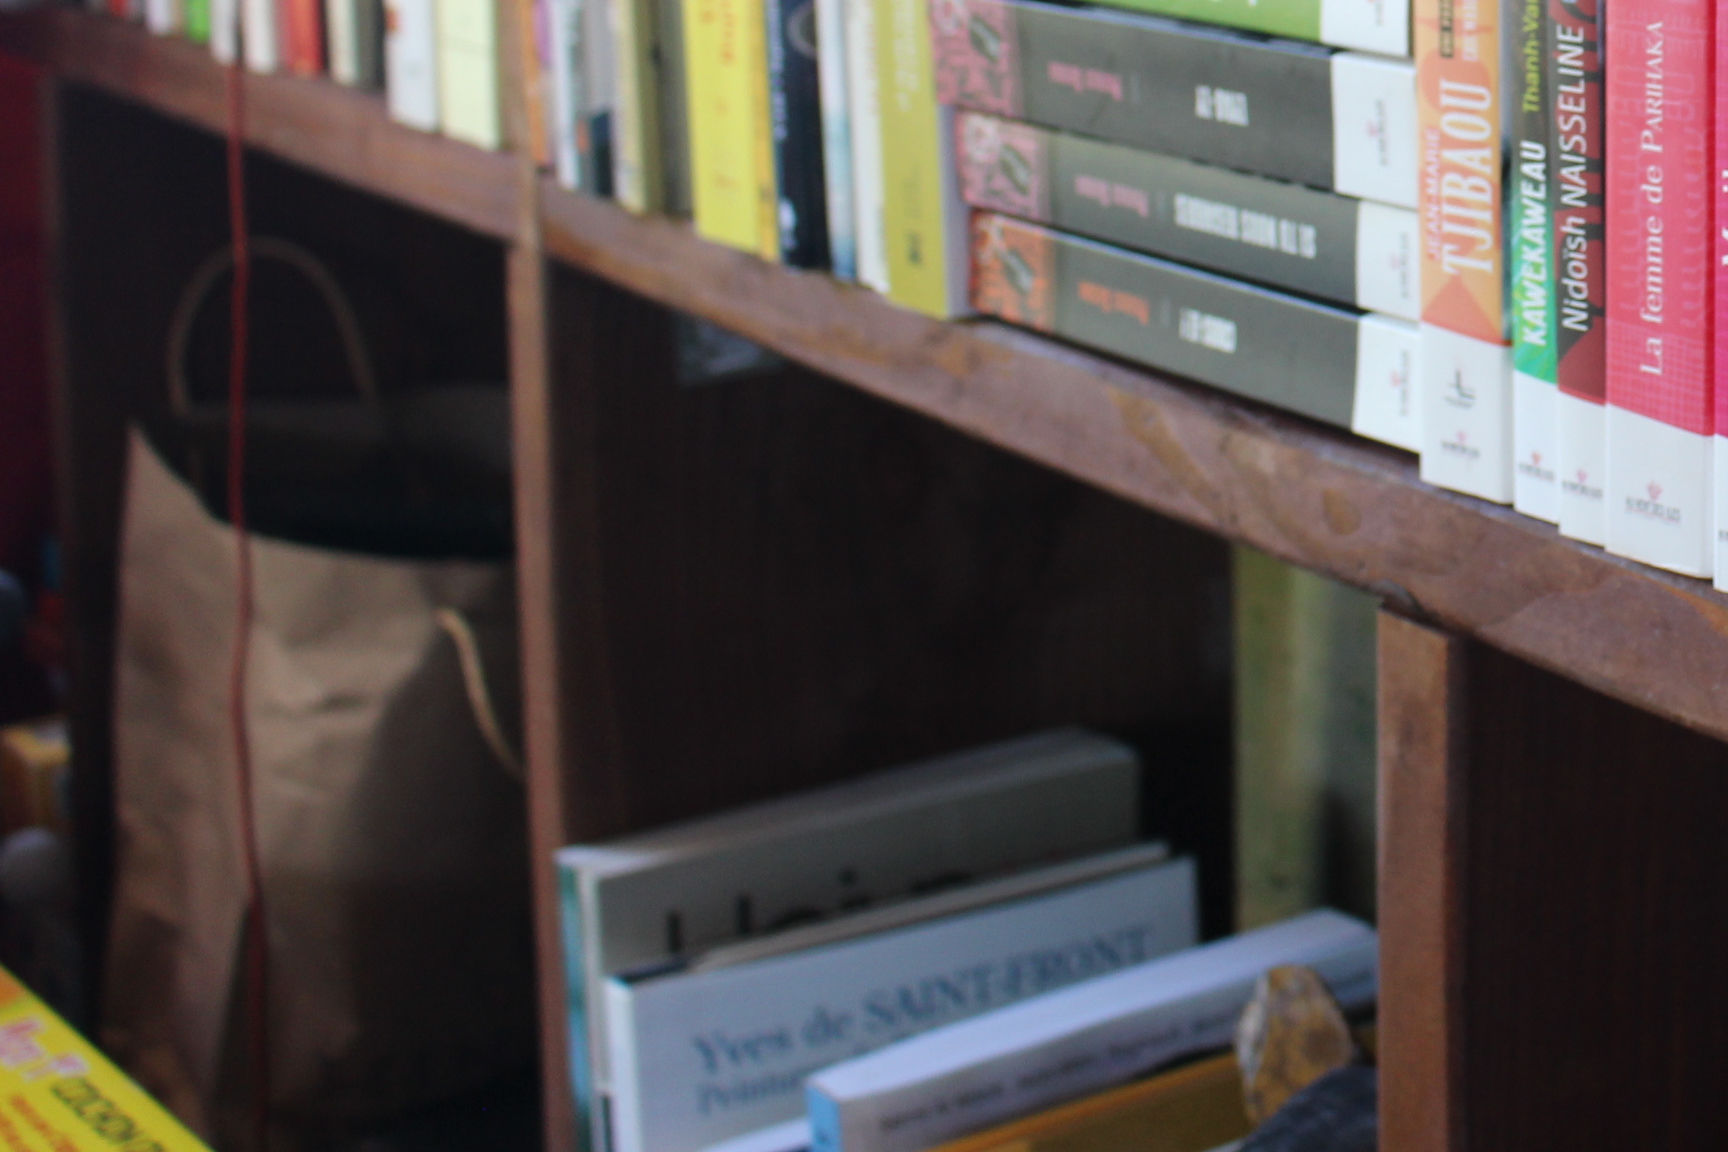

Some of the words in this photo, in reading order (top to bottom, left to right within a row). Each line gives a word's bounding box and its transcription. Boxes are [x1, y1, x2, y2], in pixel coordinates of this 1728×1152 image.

[1556, 24, 1587, 209] NAISSELINE
[1440, 78, 1494, 276] TJIBAOU
[1640, 164, 1664, 204] de
[1518, 140, 1547, 347] KAWEKAWEAU
[1561, 214, 1588, 332] Nidoïsh
[1640, 215, 1664, 324] femme
[1639, 336, 1663, 376] La
[800, 1005, 855, 1048] de
